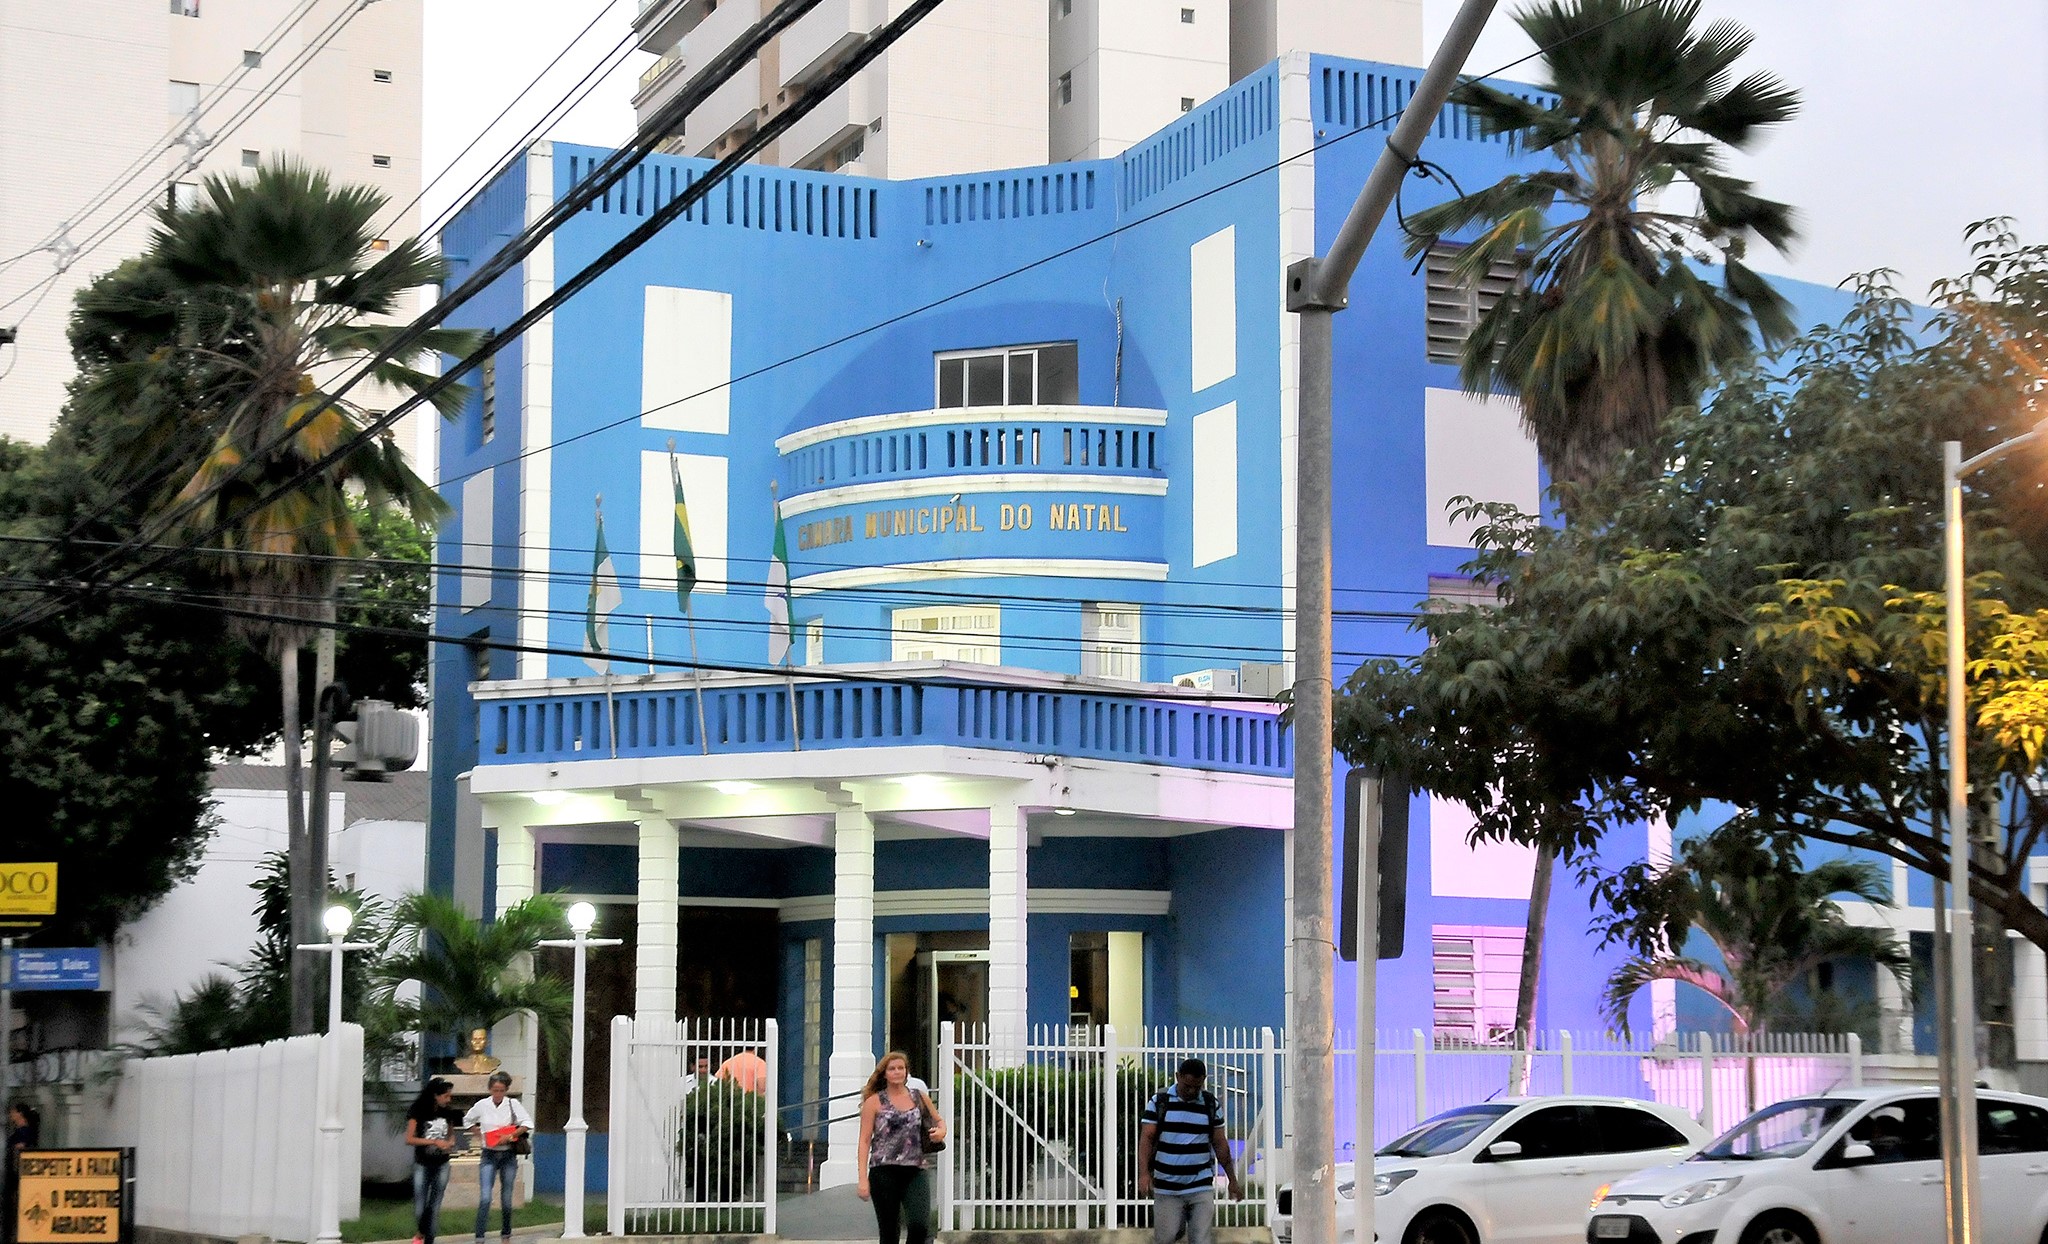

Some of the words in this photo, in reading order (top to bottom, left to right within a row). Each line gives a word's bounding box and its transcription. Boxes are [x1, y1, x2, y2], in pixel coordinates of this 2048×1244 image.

[865, 504, 984, 539] MUNICIPAL
[1000, 503, 1032, 531] DO
[1049, 503, 1128, 533] NATAL
[20, 1157, 71, 1176] RESPEITE
[76, 1157, 82, 1174] A
[51, 1190, 58, 1208] O
[64, 1190, 120, 1208] PEDESTRE
